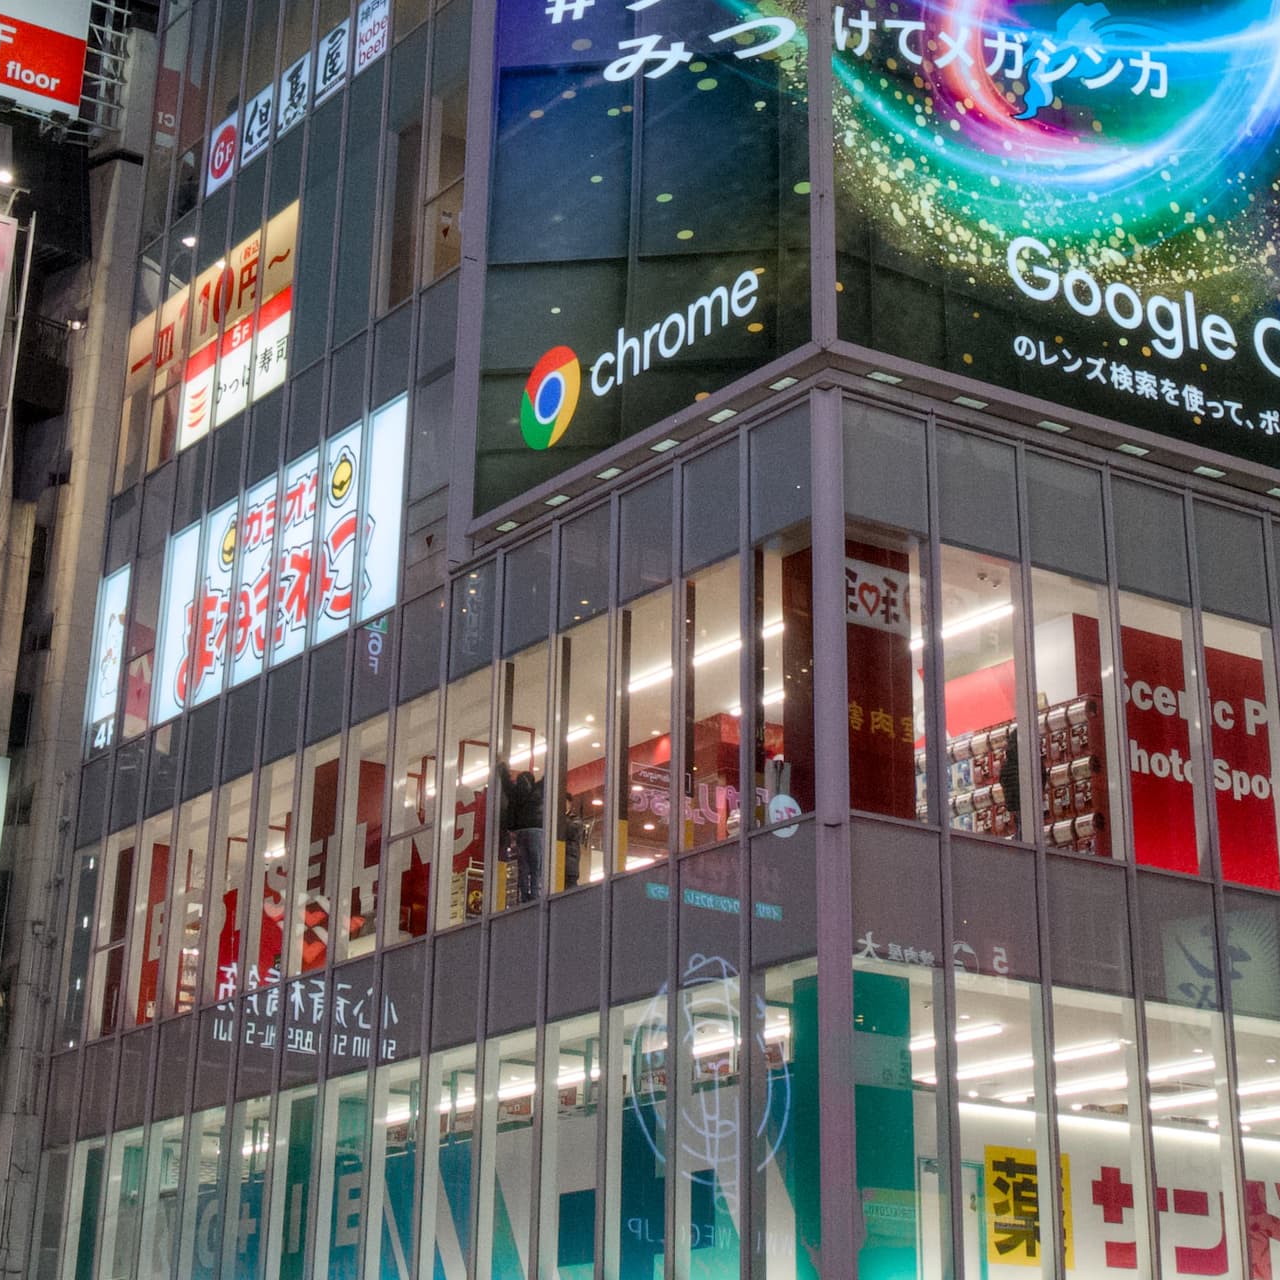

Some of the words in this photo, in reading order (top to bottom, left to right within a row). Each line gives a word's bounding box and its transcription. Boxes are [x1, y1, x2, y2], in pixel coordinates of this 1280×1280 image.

[358, 16, 389, 48] kobe
[359, 31, 387, 66] beef
[602, 7, 1170, 102] みつけてメガシンカ
[6, 58, 61, 92] floor
[214, 139, 235, 170] 6F
[1007, 235, 1237, 361] Google
[231, 323, 251, 348] 5F
[590, 269, 762, 399] chrome
[1122, 672, 1235, 730] ceic
[1129, 739, 1193, 784] hoto
[991, 1157, 1069, 1258] 薬
